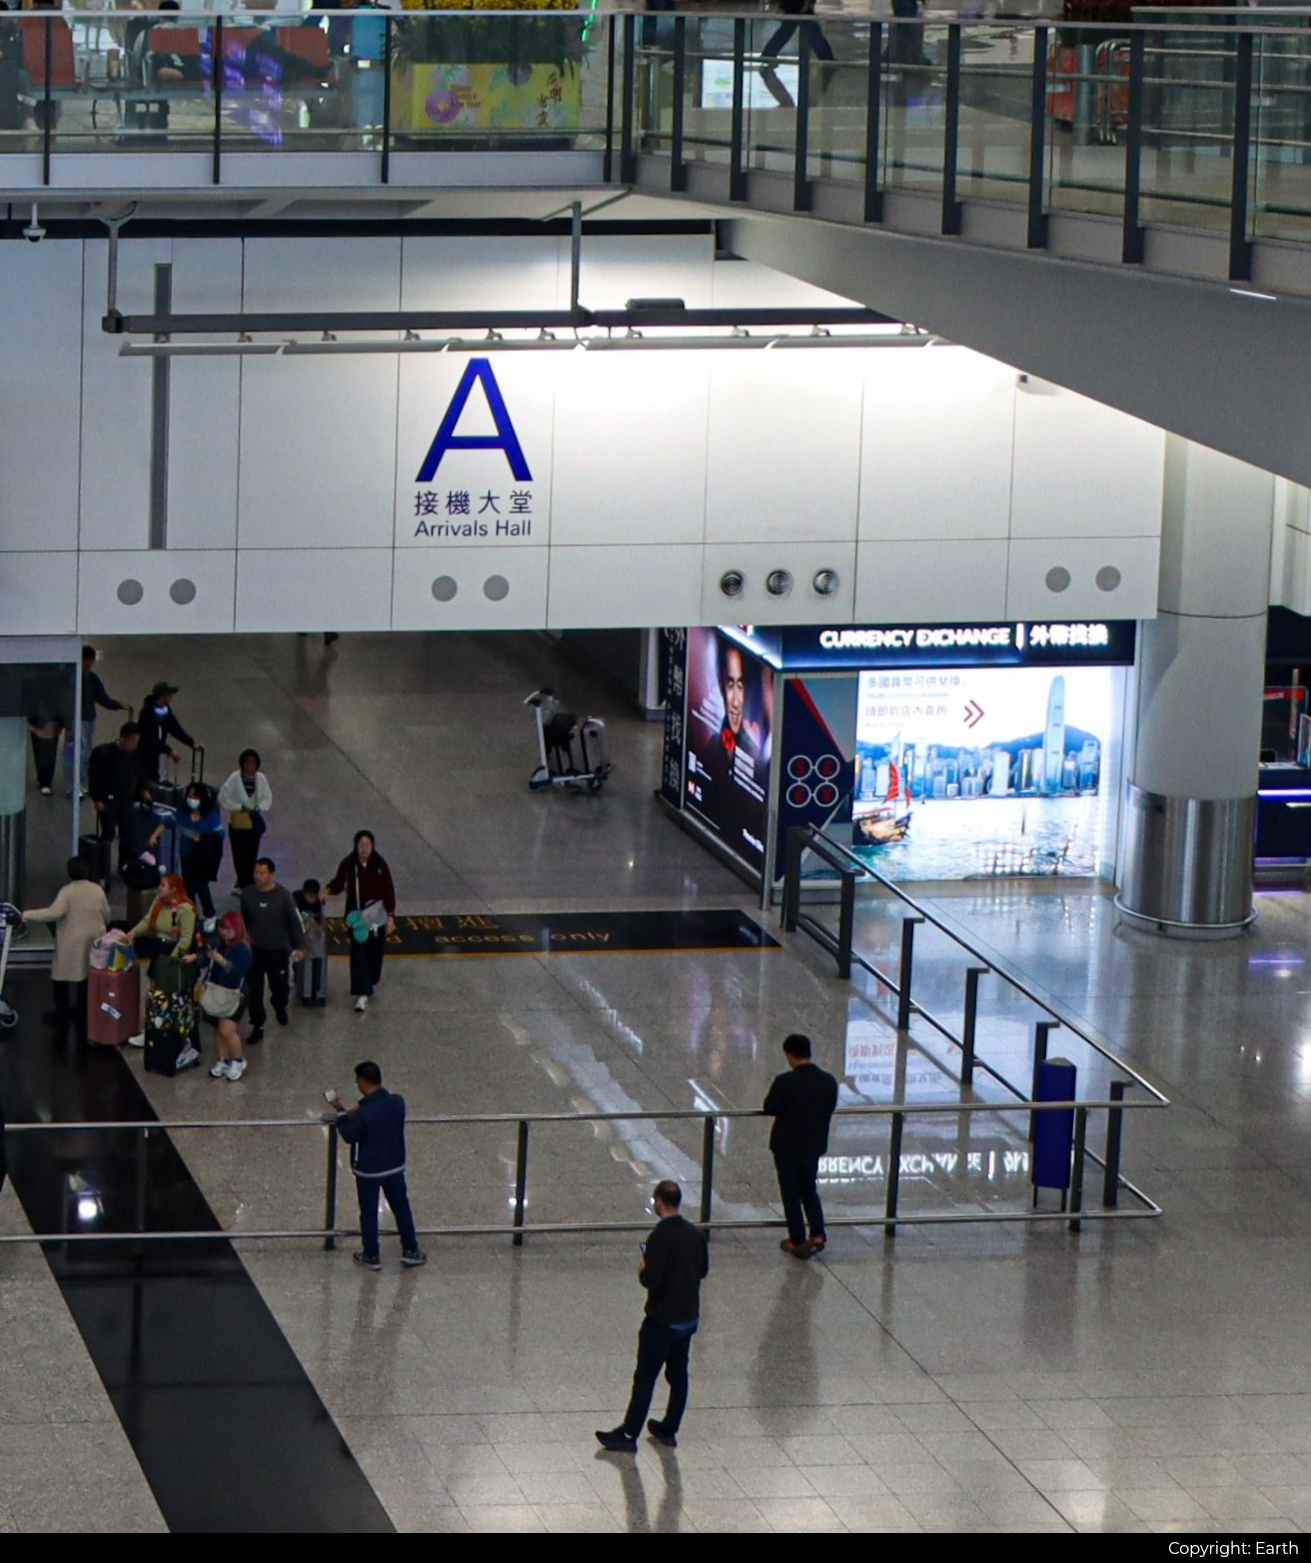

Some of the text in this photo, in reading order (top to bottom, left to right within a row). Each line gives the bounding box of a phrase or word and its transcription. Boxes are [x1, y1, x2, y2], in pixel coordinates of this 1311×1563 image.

[415, 358, 533, 482] A
[415, 490, 533, 516] 接機大堂
[415, 519, 531, 537] Arrivals Hall
[820, 627, 1010, 648] CURRENCY EXCHANGE
[434, 931, 611, 944] access only
